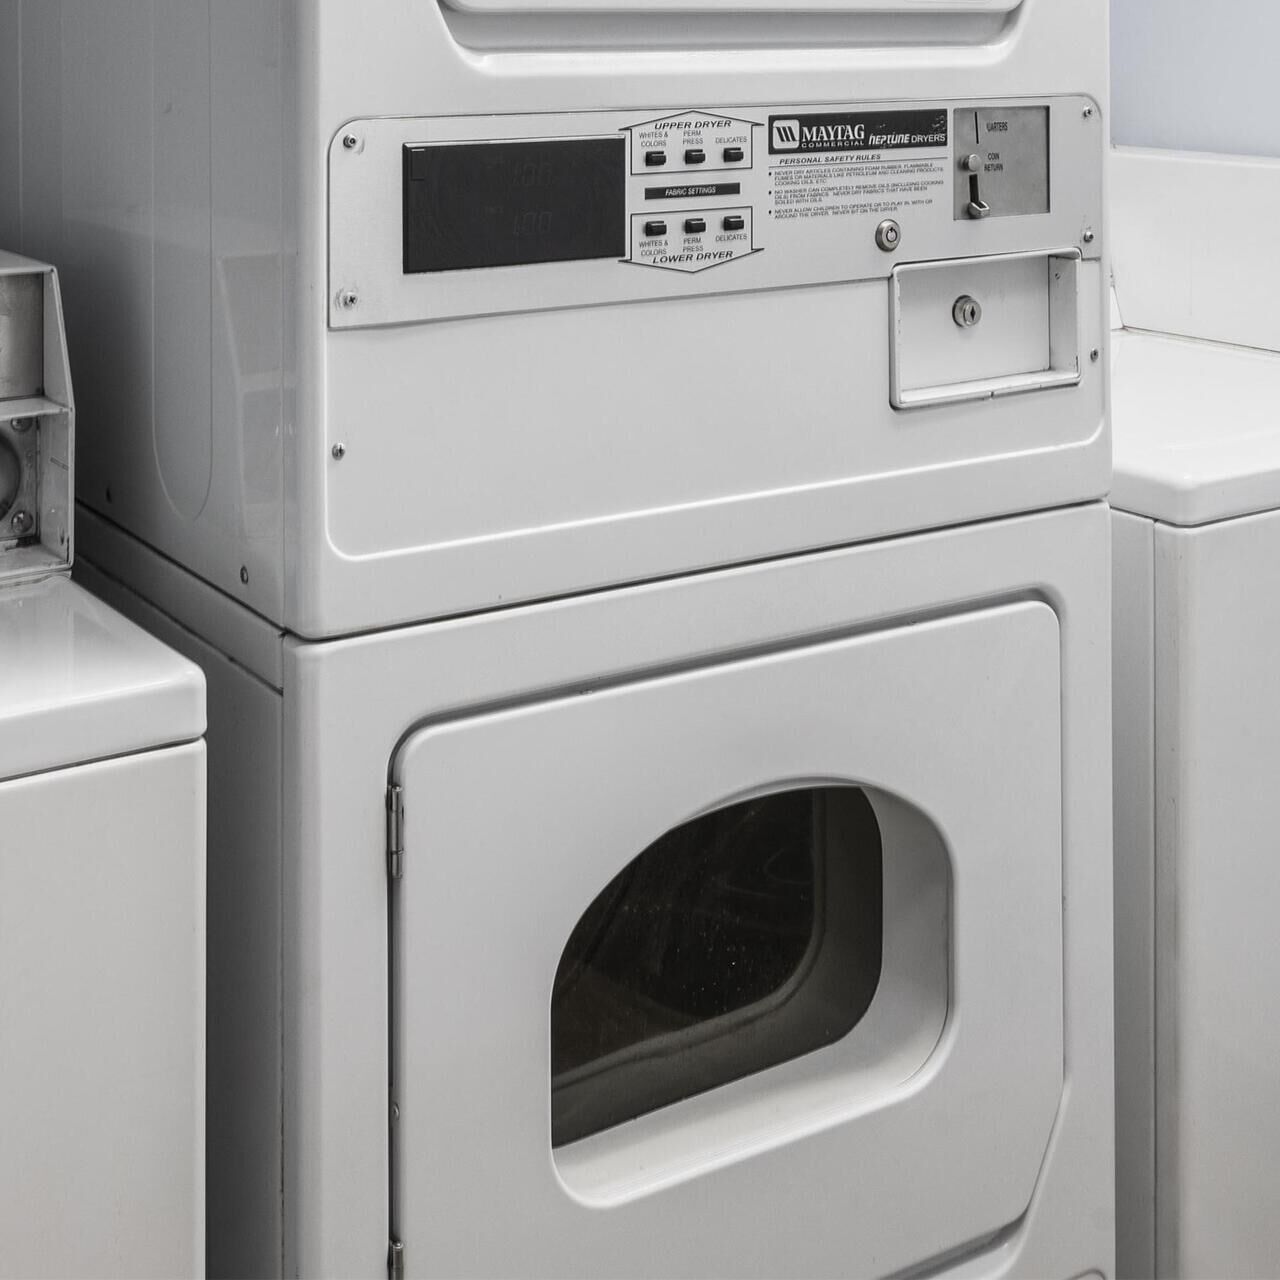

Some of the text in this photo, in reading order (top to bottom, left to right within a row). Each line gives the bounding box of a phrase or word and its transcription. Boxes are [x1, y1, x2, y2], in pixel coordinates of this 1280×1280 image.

[654, 120, 732, 130] UPPER DRYER
[639, 131, 663, 139] WHITES
[802, 124, 865, 142] MAYTAG
[715, 136, 747, 144] DELICATES
[911, 133, 946, 143] DRYERS
[641, 139, 667, 147] COLORS
[801, 140, 865, 149] COMMERCIAL
[780, 157, 822, 165] PERSONAL
[824, 155, 855, 163] SAFETY
[665, 186, 717, 196] FABRIC SETTINGS
[715, 233, 748, 242] DELICATES
[639, 240, 663, 248] WHITES
[641, 249, 667, 257] COLORS
[652, 251, 734, 264] LOWER DRYER
